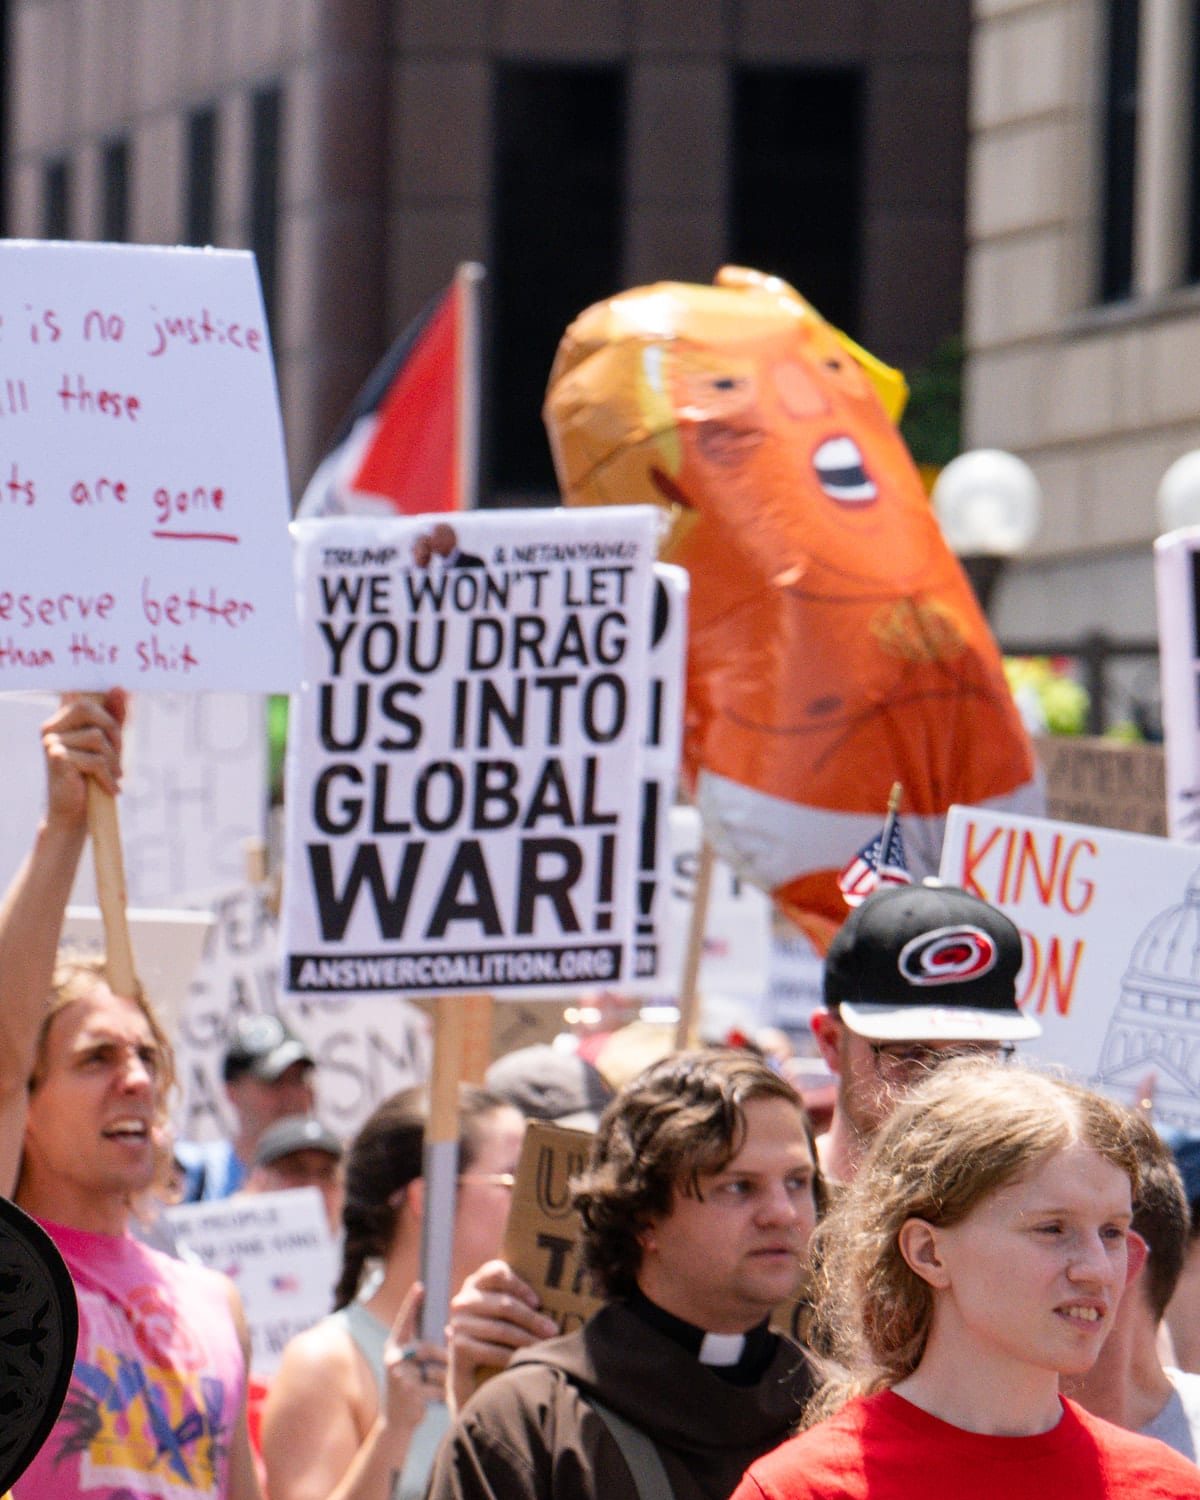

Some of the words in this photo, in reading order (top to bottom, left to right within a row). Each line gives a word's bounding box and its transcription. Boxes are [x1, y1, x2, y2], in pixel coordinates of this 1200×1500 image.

[27, 304, 61, 344] is
[83, 308, 125, 343] no
[148, 305, 262, 357] justice
[58, 376, 141, 421] these
[72, 478, 127, 505] are
[154, 485, 225, 524] gone
[323, 547, 398, 566] TRUMP
[142, 582, 256, 628] better
[320, 575, 391, 616] WE
[407, 567, 550, 611] WON'T
[564, 566, 633, 607] LET
[319, 618, 447, 677] YOU
[465, 610, 627, 671] DRAG
[319, 680, 423, 752] US
[452, 673, 628, 748] INTO
[313, 757, 619, 836] GLOBAL
[307, 833, 617, 942] WAR!
[961, 821, 1097, 916] KING
[297, 950, 616, 990] ANSWERCOALITION.ORG
